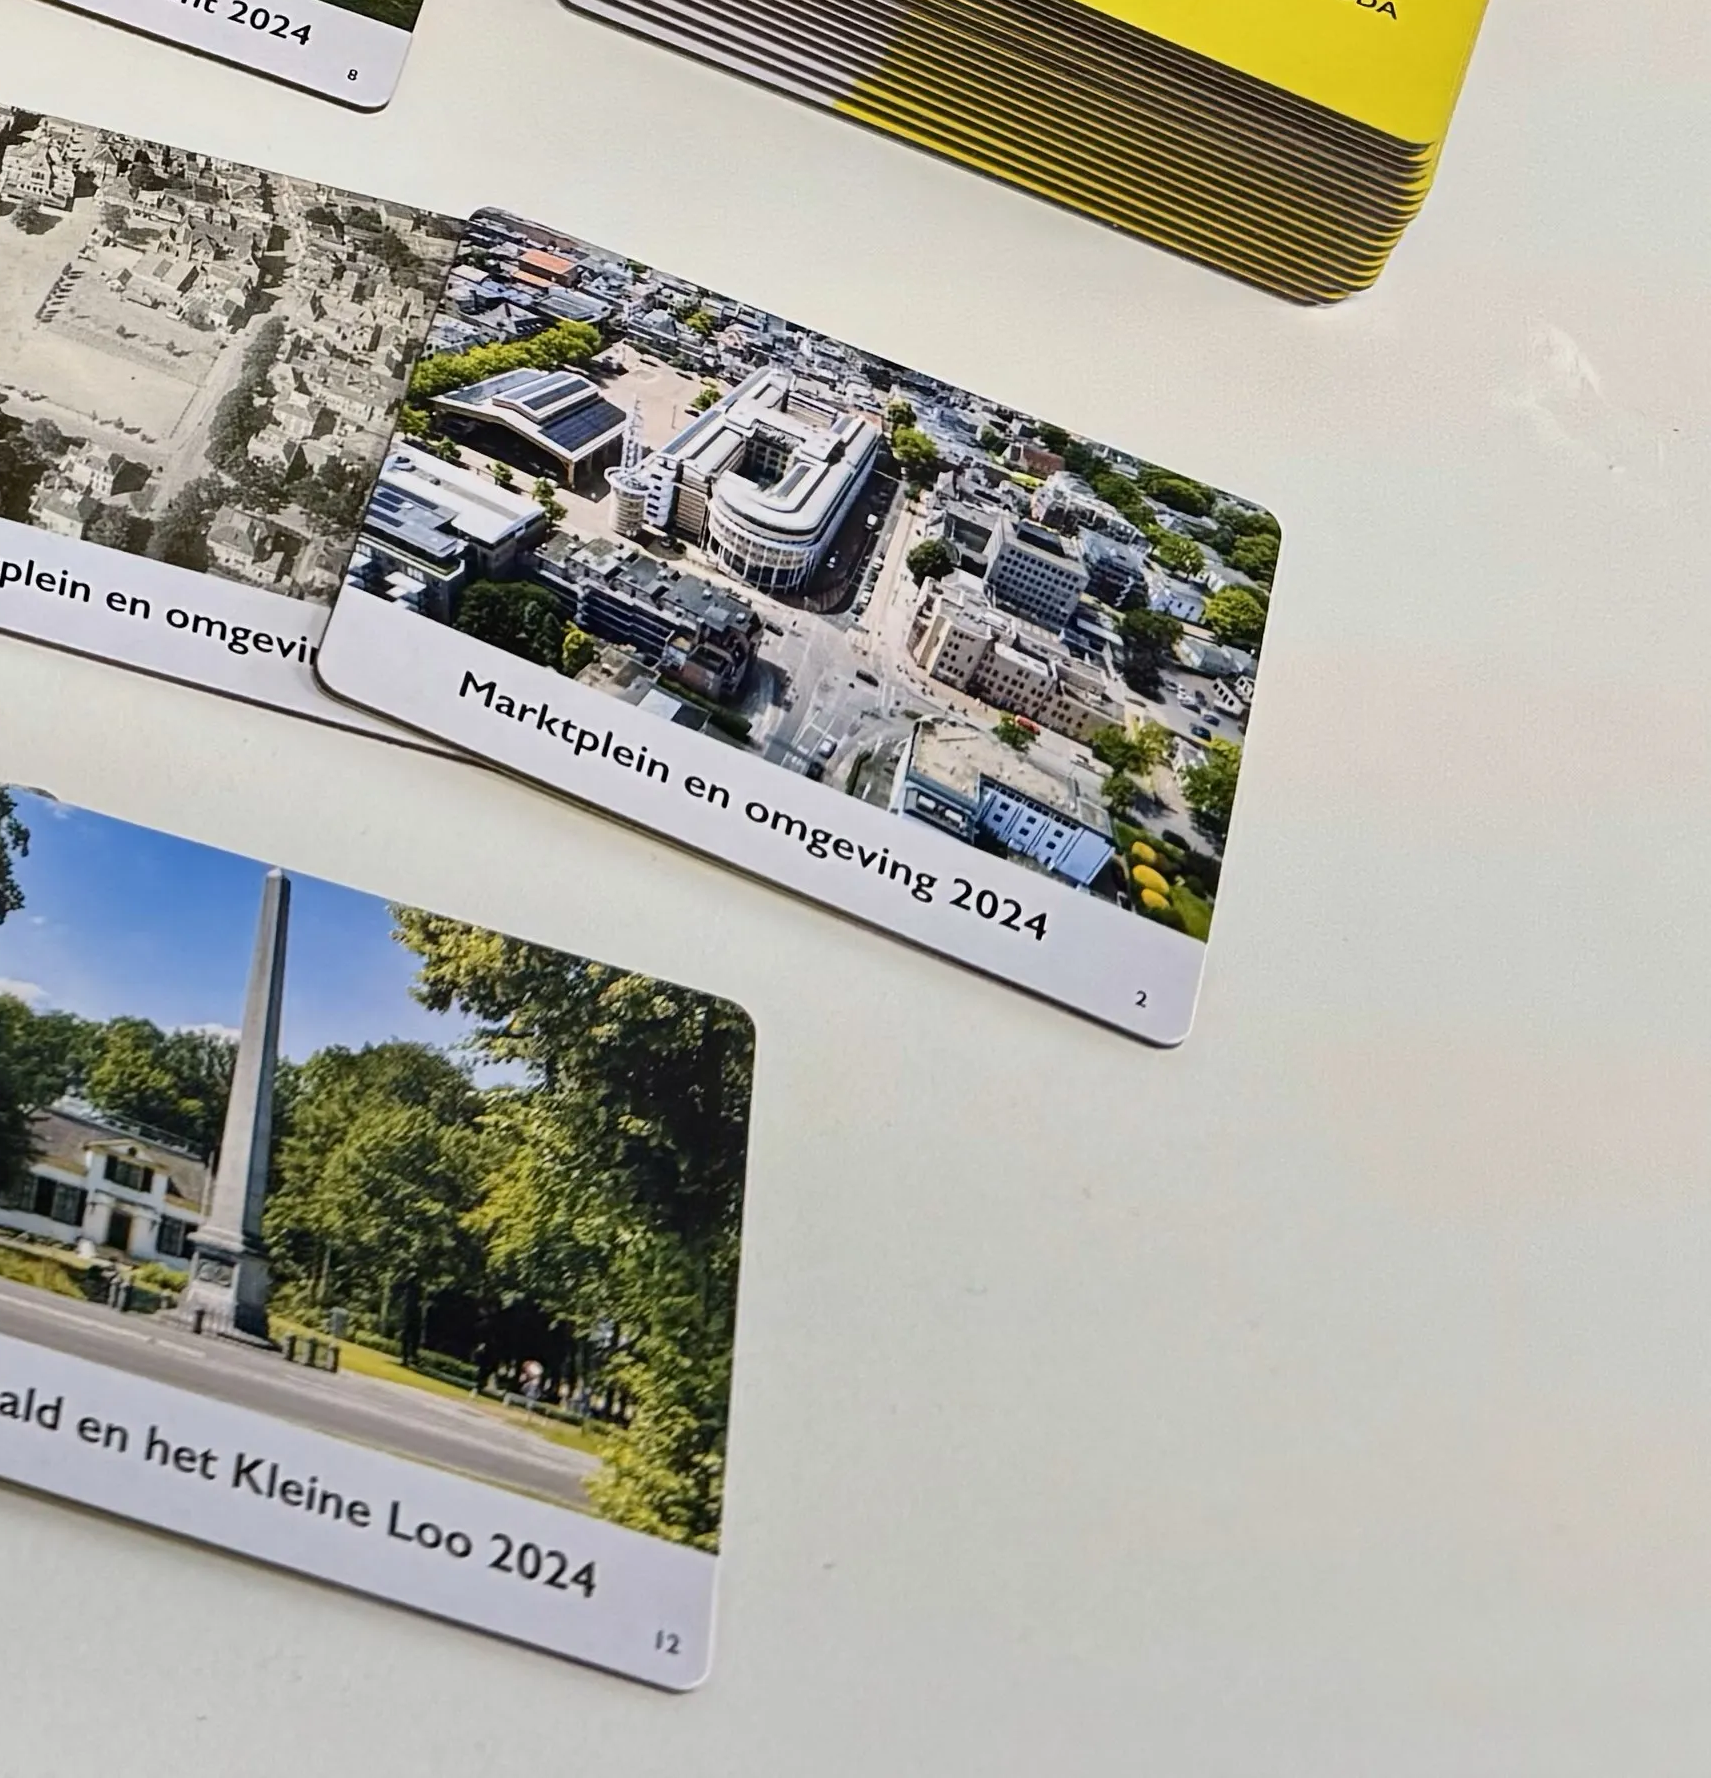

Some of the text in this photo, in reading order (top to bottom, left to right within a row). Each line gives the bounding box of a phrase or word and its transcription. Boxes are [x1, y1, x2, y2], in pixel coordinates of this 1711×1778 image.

[228, 0, 311, 45] 2024
[347, 68, 358, 81] 8
[107, 593, 150, 619] en
[460, 671, 1046, 940] Marktplein en omgeving 2024
[1135, 990, 1147, 1008] 2
[78, 1418, 127, 1452] en
[146, 1426, 217, 1479] het
[233, 1454, 370, 1527] Kleine
[389, 1502, 471, 1557] Loo
[490, 1534, 595, 1597] 2024
[655, 1630, 680, 1655] 12
